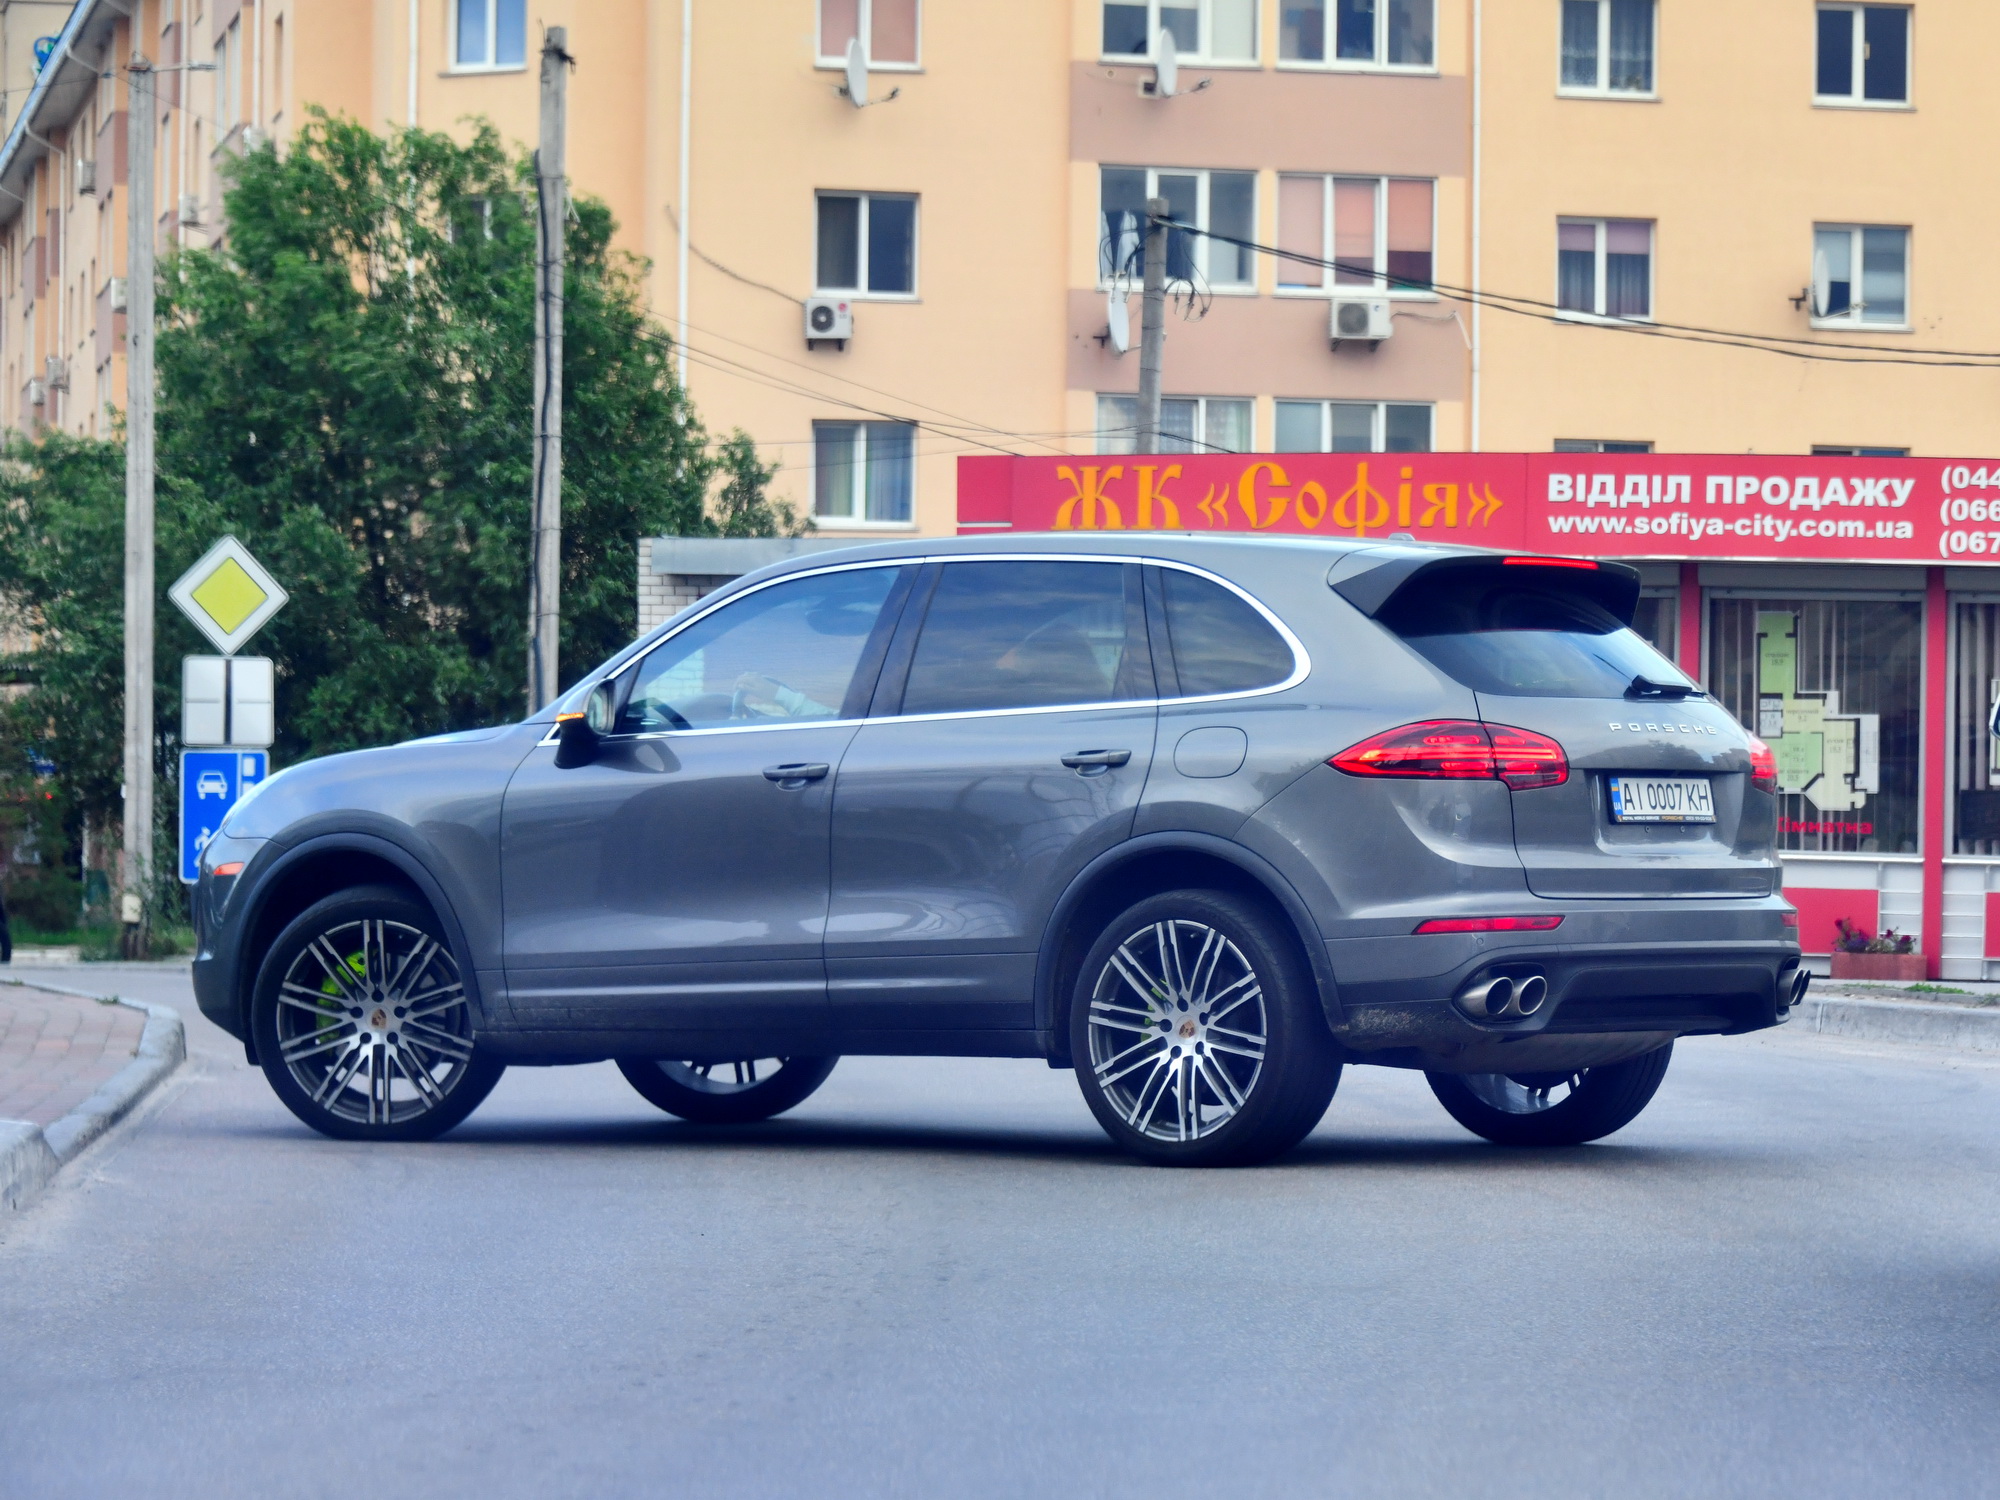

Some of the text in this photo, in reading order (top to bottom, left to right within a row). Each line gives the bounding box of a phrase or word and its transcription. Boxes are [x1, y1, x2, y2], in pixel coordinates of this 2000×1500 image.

[1547, 474, 1915, 511] ВІДДІЛ ПРОДАЖУ
[1940, 466, 2000, 494] (044
[1051, 464, 1185, 530] ЖК
[1547, 512, 1914, 542] www.sofiya-city.com.ua
[1939, 530, 2000, 559] (067
[1608, 722, 1717, 735] PORSCHE
[1613, 802, 1622, 811] UA
[1624, 783, 1710, 812] AI 0007 KH
